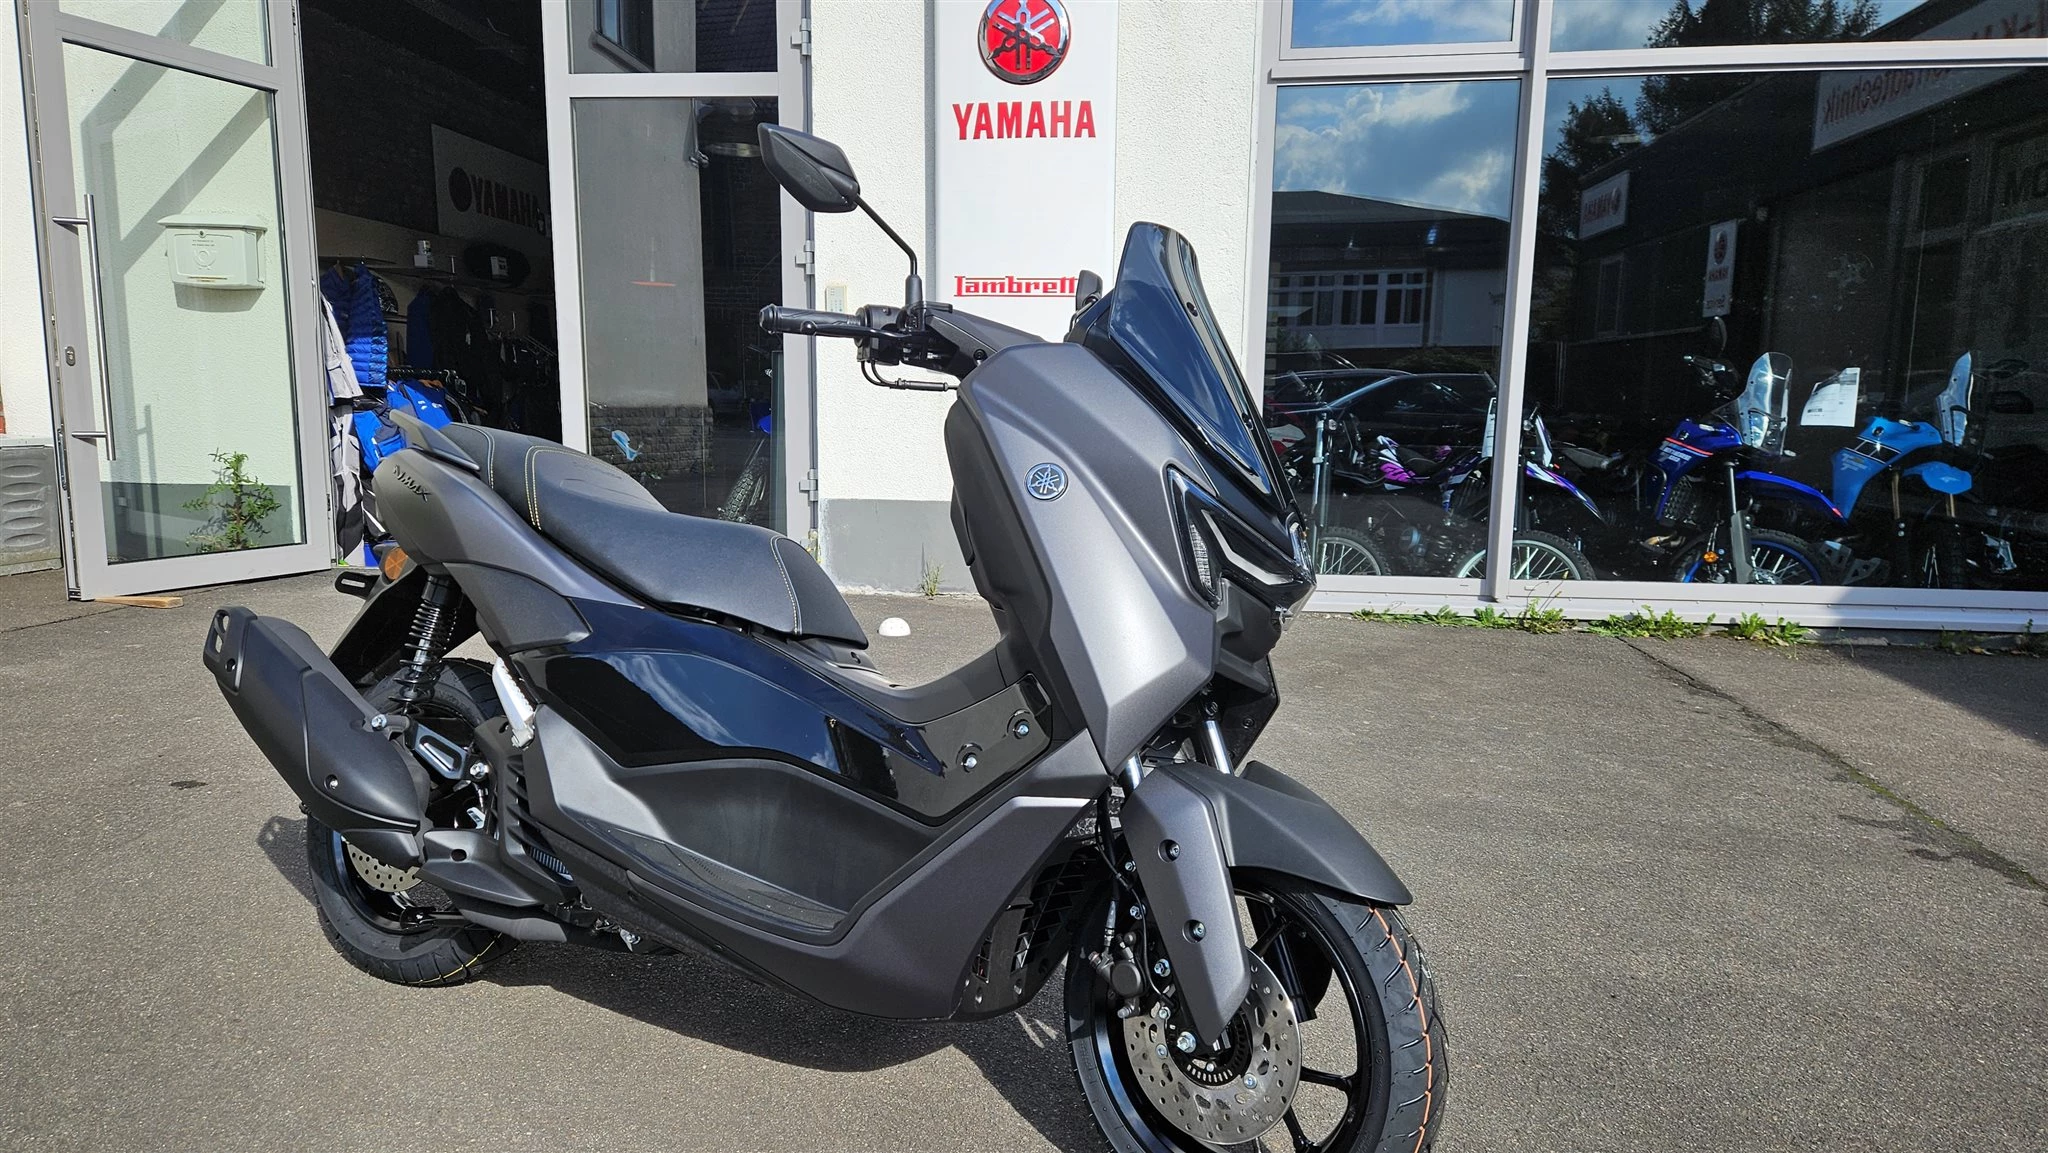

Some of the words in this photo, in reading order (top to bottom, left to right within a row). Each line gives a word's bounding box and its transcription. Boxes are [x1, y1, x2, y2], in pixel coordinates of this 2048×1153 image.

[952, 100, 1097, 141] YAMAHA
[469, 174, 542, 230] YAMAHA
[954, 275, 1078, 298] Lambrett
[392, 464, 432, 503] NMAX
